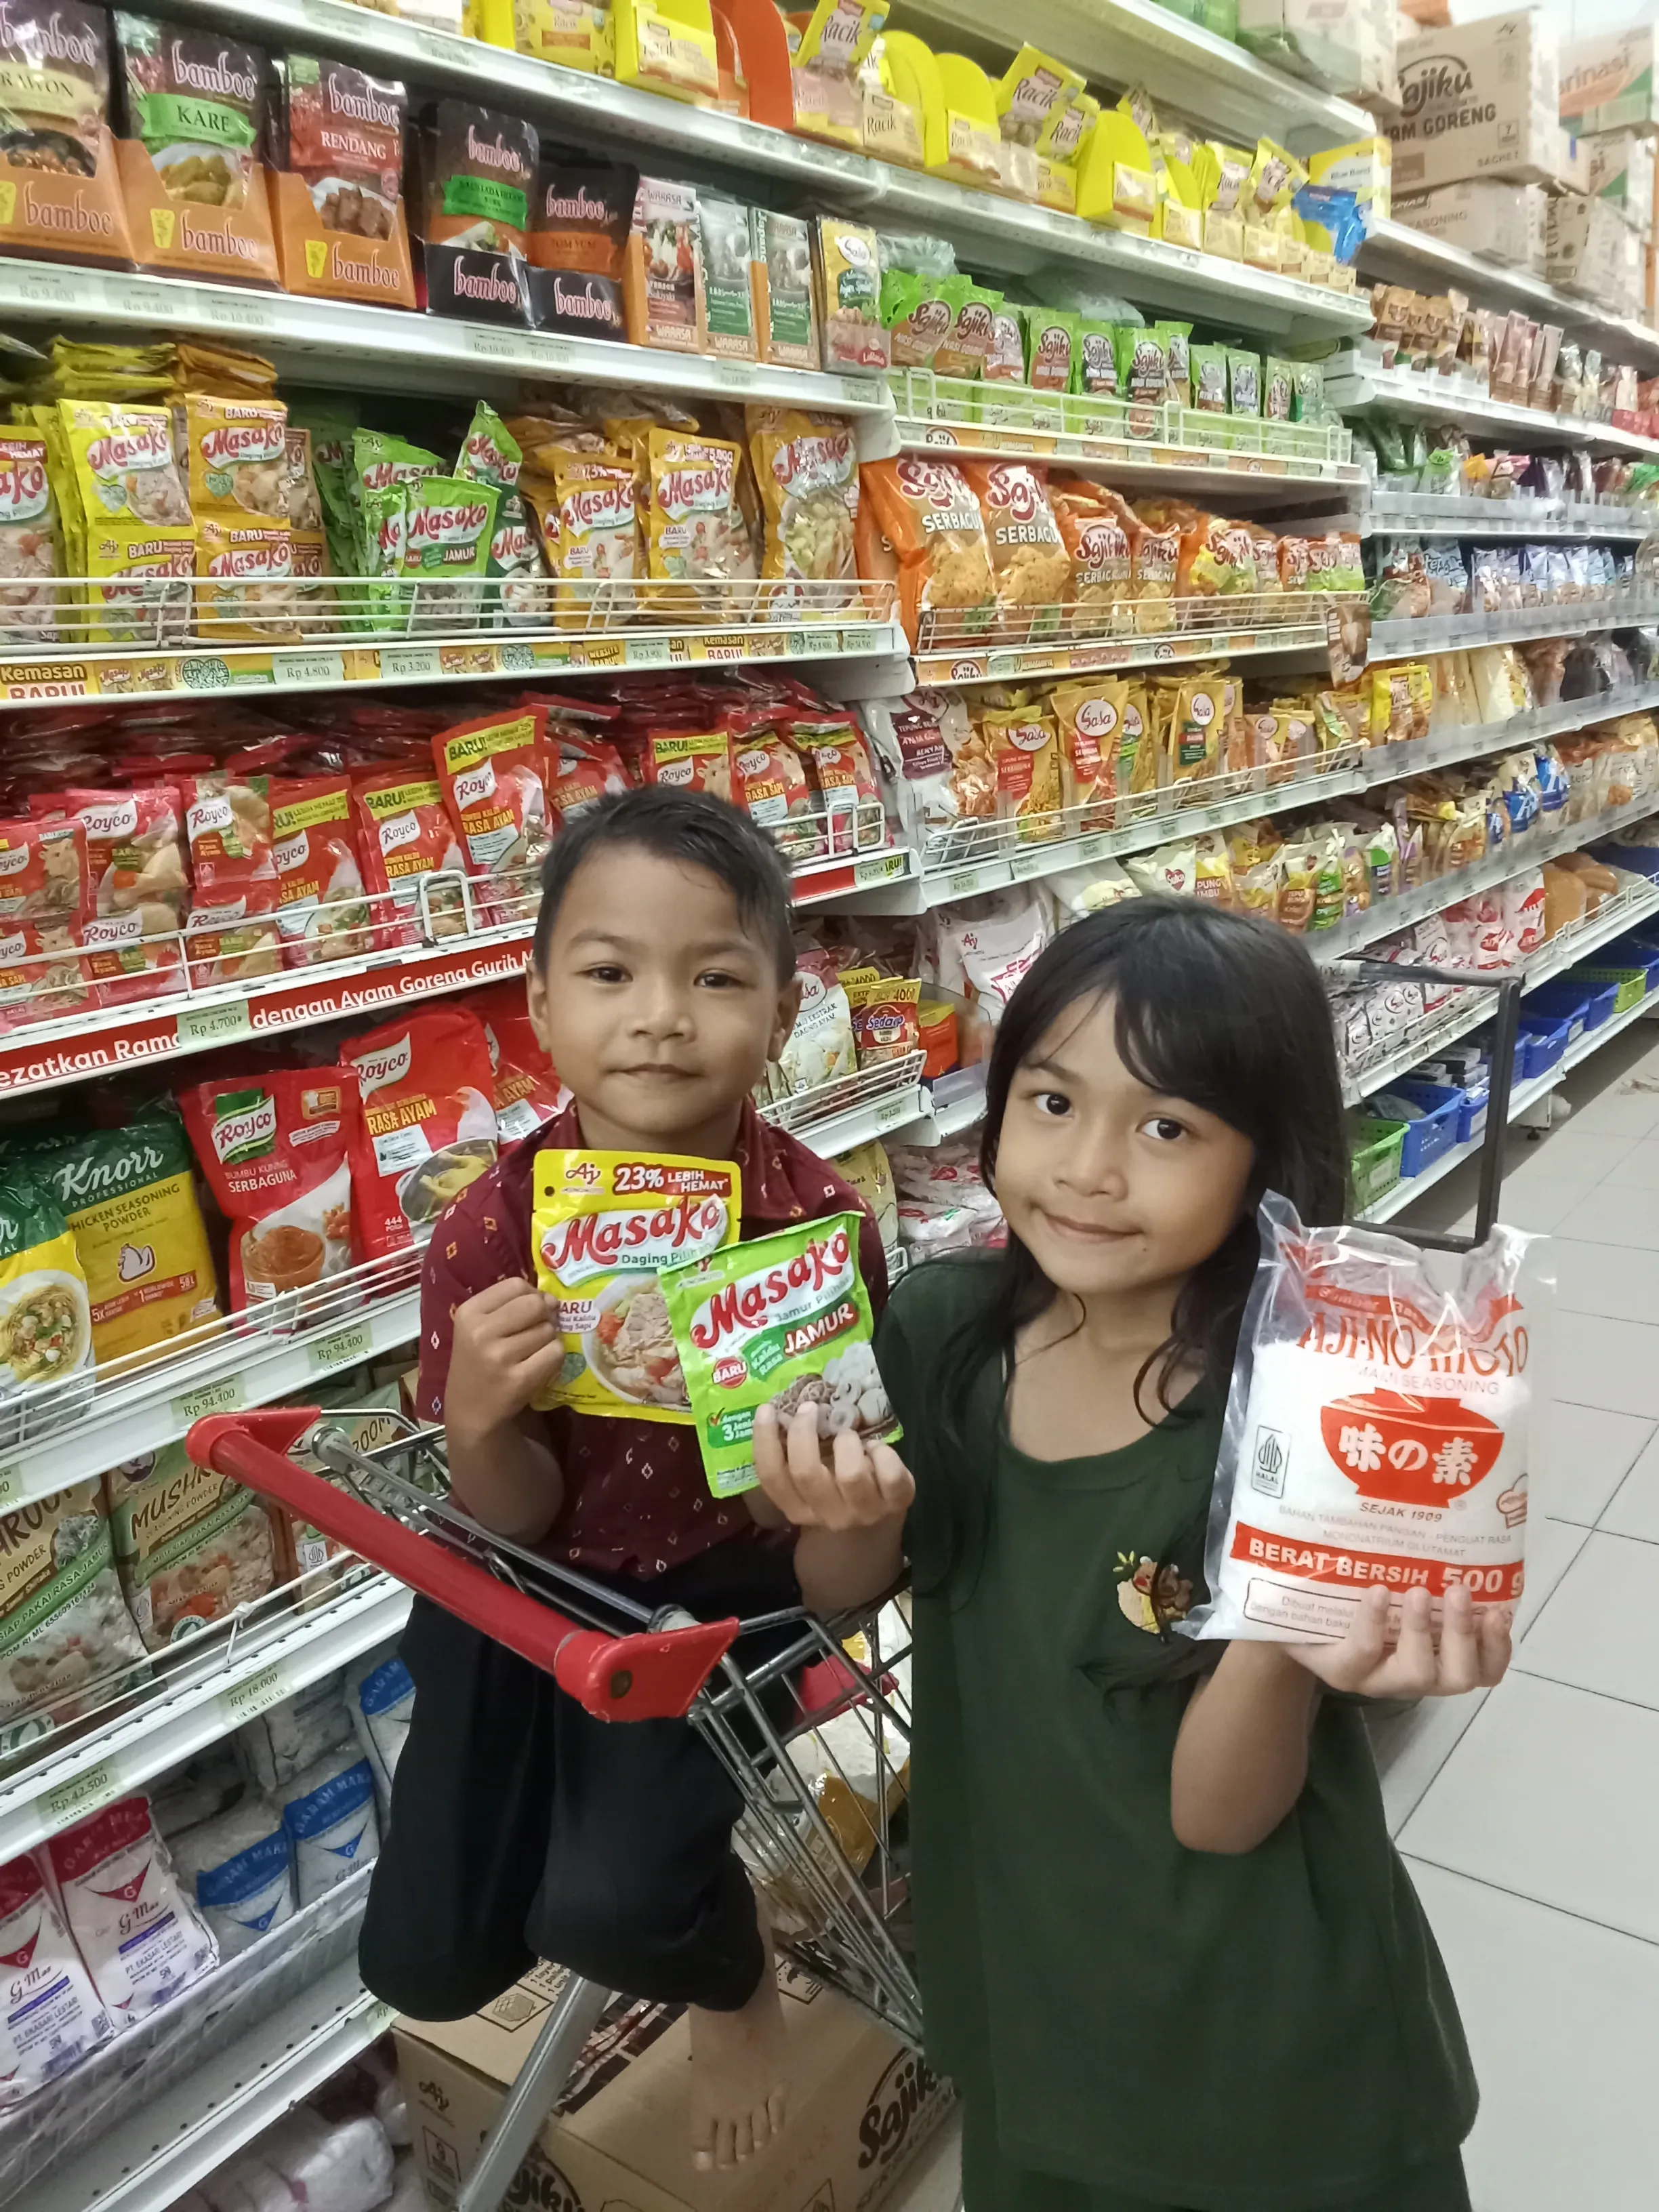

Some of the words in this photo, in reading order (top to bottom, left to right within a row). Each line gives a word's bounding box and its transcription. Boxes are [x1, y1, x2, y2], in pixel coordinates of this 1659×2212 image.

[1013, 78, 1059, 110] Racik
[176, 105, 230, 133] KARE
[1424, 103, 1496, 134] GORENG
[321, 129, 387, 161] RENDANG
[24, 181, 113, 236] bamboe
[546, 184, 605, 220] bamboe
[180, 209, 259, 261] bamboe
[331, 241, 401, 289] bamboe
[453, 255, 517, 304] bamboe
[554, 277, 611, 321] bamboe
[909, 304, 949, 335] Sajiku
[225, 407, 258, 419] BARU
[202, 420, 285, 459] Masako
[407, 501, 488, 541] Masako
[922, 512, 983, 534] SERBAGU
[230, 529, 264, 543] BARU
[995, 525, 1061, 546] SERBAGU
[127, 540, 163, 559] BARU
[443, 546, 476, 562] JAMUR
[1, 663, 85, 681] Kemasan
[287, 667, 302, 679] Rp
[303, 665, 330, 678] 4.800
[392, 663, 406, 674] Rp
[408, 661, 431, 673] 3.200
[448, 738, 487, 762] BARU!
[655, 740, 689, 754] BARU!
[659, 766, 692, 784] Royco
[365, 790, 407, 809] BARU!
[745, 785, 769, 802] RASA
[770, 782, 785, 796] SAPI
[190, 806, 228, 829] Royco
[464, 817, 492, 835] RASA
[493, 809, 516, 830] AYAM
[381, 821, 417, 846] Royco
[386, 860, 411, 878] RASA
[413, 857, 435, 873] AYAM
[296, 880, 321, 899] AYAM
[84, 922, 138, 943] Royco
[0, 1049, 109, 1087] ezatkan
[253, 996, 336, 1029] dengan
[341, 983, 396, 1011] Ayam
[399, 967, 468, 996] Goreng
[470, 952, 519, 980] Gurih
[190, 1023, 207, 1038] Rp
[505, 1076, 537, 1104] AYAM
[216, 1112, 272, 1149] Royco
[366, 1108, 399, 1136] RASA
[401, 1099, 438, 1128] AYAM
[52, 1146, 164, 1202] Knorr
[224, 1166, 256, 1181] BUMBU
[228, 1168, 298, 1193] SERBAGUNA
[615, 1166, 665, 1192] 23%
[668, 1170, 705, 1184] LEBIH
[72, 1171, 159, 1208] PROFESSIONAL
[117, 1183, 181, 1216] SEASONING
[102, 1207, 151, 1232] POWDER
[541, 1195, 720, 1270] Masako
[621, 1253, 668, 1267] Daging
[691, 1231, 850, 1349] Masako
[558, 1300, 593, 1315] ARU
[774, 1301, 813, 1322] Jamur
[784, 1302, 855, 1355] JAMUR
[319, 1349, 332, 1361] Rp
[333, 1334, 364, 1355] 94.400
[712, 1361, 747, 1385] BARU
[1401, 1374, 1500, 1395] SEASONING
[184, 1405, 200, 1416] Rp
[202, 1388, 235, 1409] 94.400
[722, 1422, 735, 1442] 3
[1338, 1422, 1479, 1486] 味の素
[1255, 1471, 1280, 1486] HALAL
[131, 1467, 213, 1540] MUSHR
[1359, 1501, 1406, 1518] SEJAK
[1411, 1510, 1443, 1523] 1909
[6, 1543, 48, 1586] POWDER
[1249, 1537, 1330, 1572] BERAT
[1336, 1555, 1429, 1585] BERSIH
[1441, 1567, 1504, 1594] 500
[22, 1593, 53, 1624] PAKAI
[52, 1570, 81, 1597] RASA
[81, 1540, 110, 1576] JAMUR
[1291, 1610, 1324, 1626] bahan
[230, 1693, 246, 1708] Rp
[247, 1672, 279, 1699] 18.000
[51, 1797, 69, 1815] Rp
[71, 1774, 108, 1802] 42.500
[858, 2055, 939, 2170] Sajik
